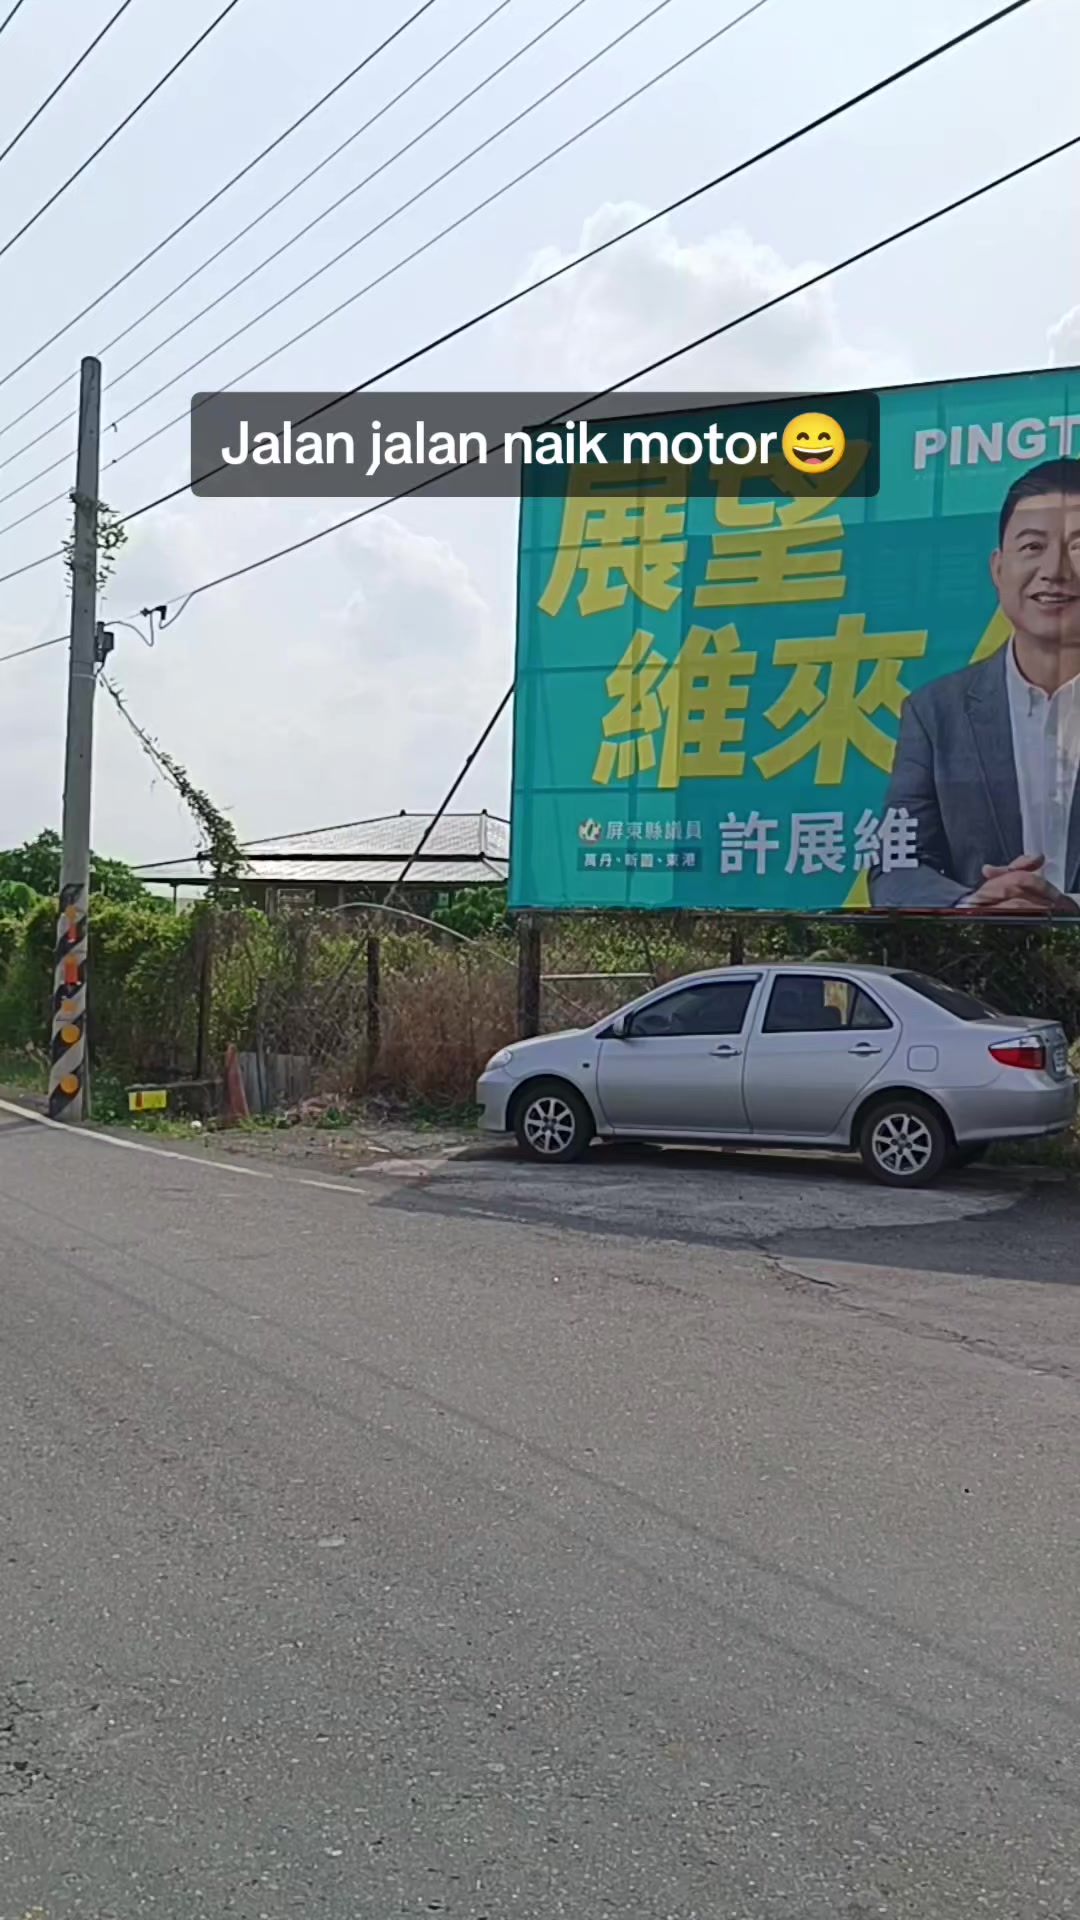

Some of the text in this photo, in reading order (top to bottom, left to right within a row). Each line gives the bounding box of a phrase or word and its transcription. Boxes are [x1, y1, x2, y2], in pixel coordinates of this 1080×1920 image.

[537, 440, 872, 617] 展望
[591, 613, 928, 789] 維來
[718, 807, 919, 875] 許展維
